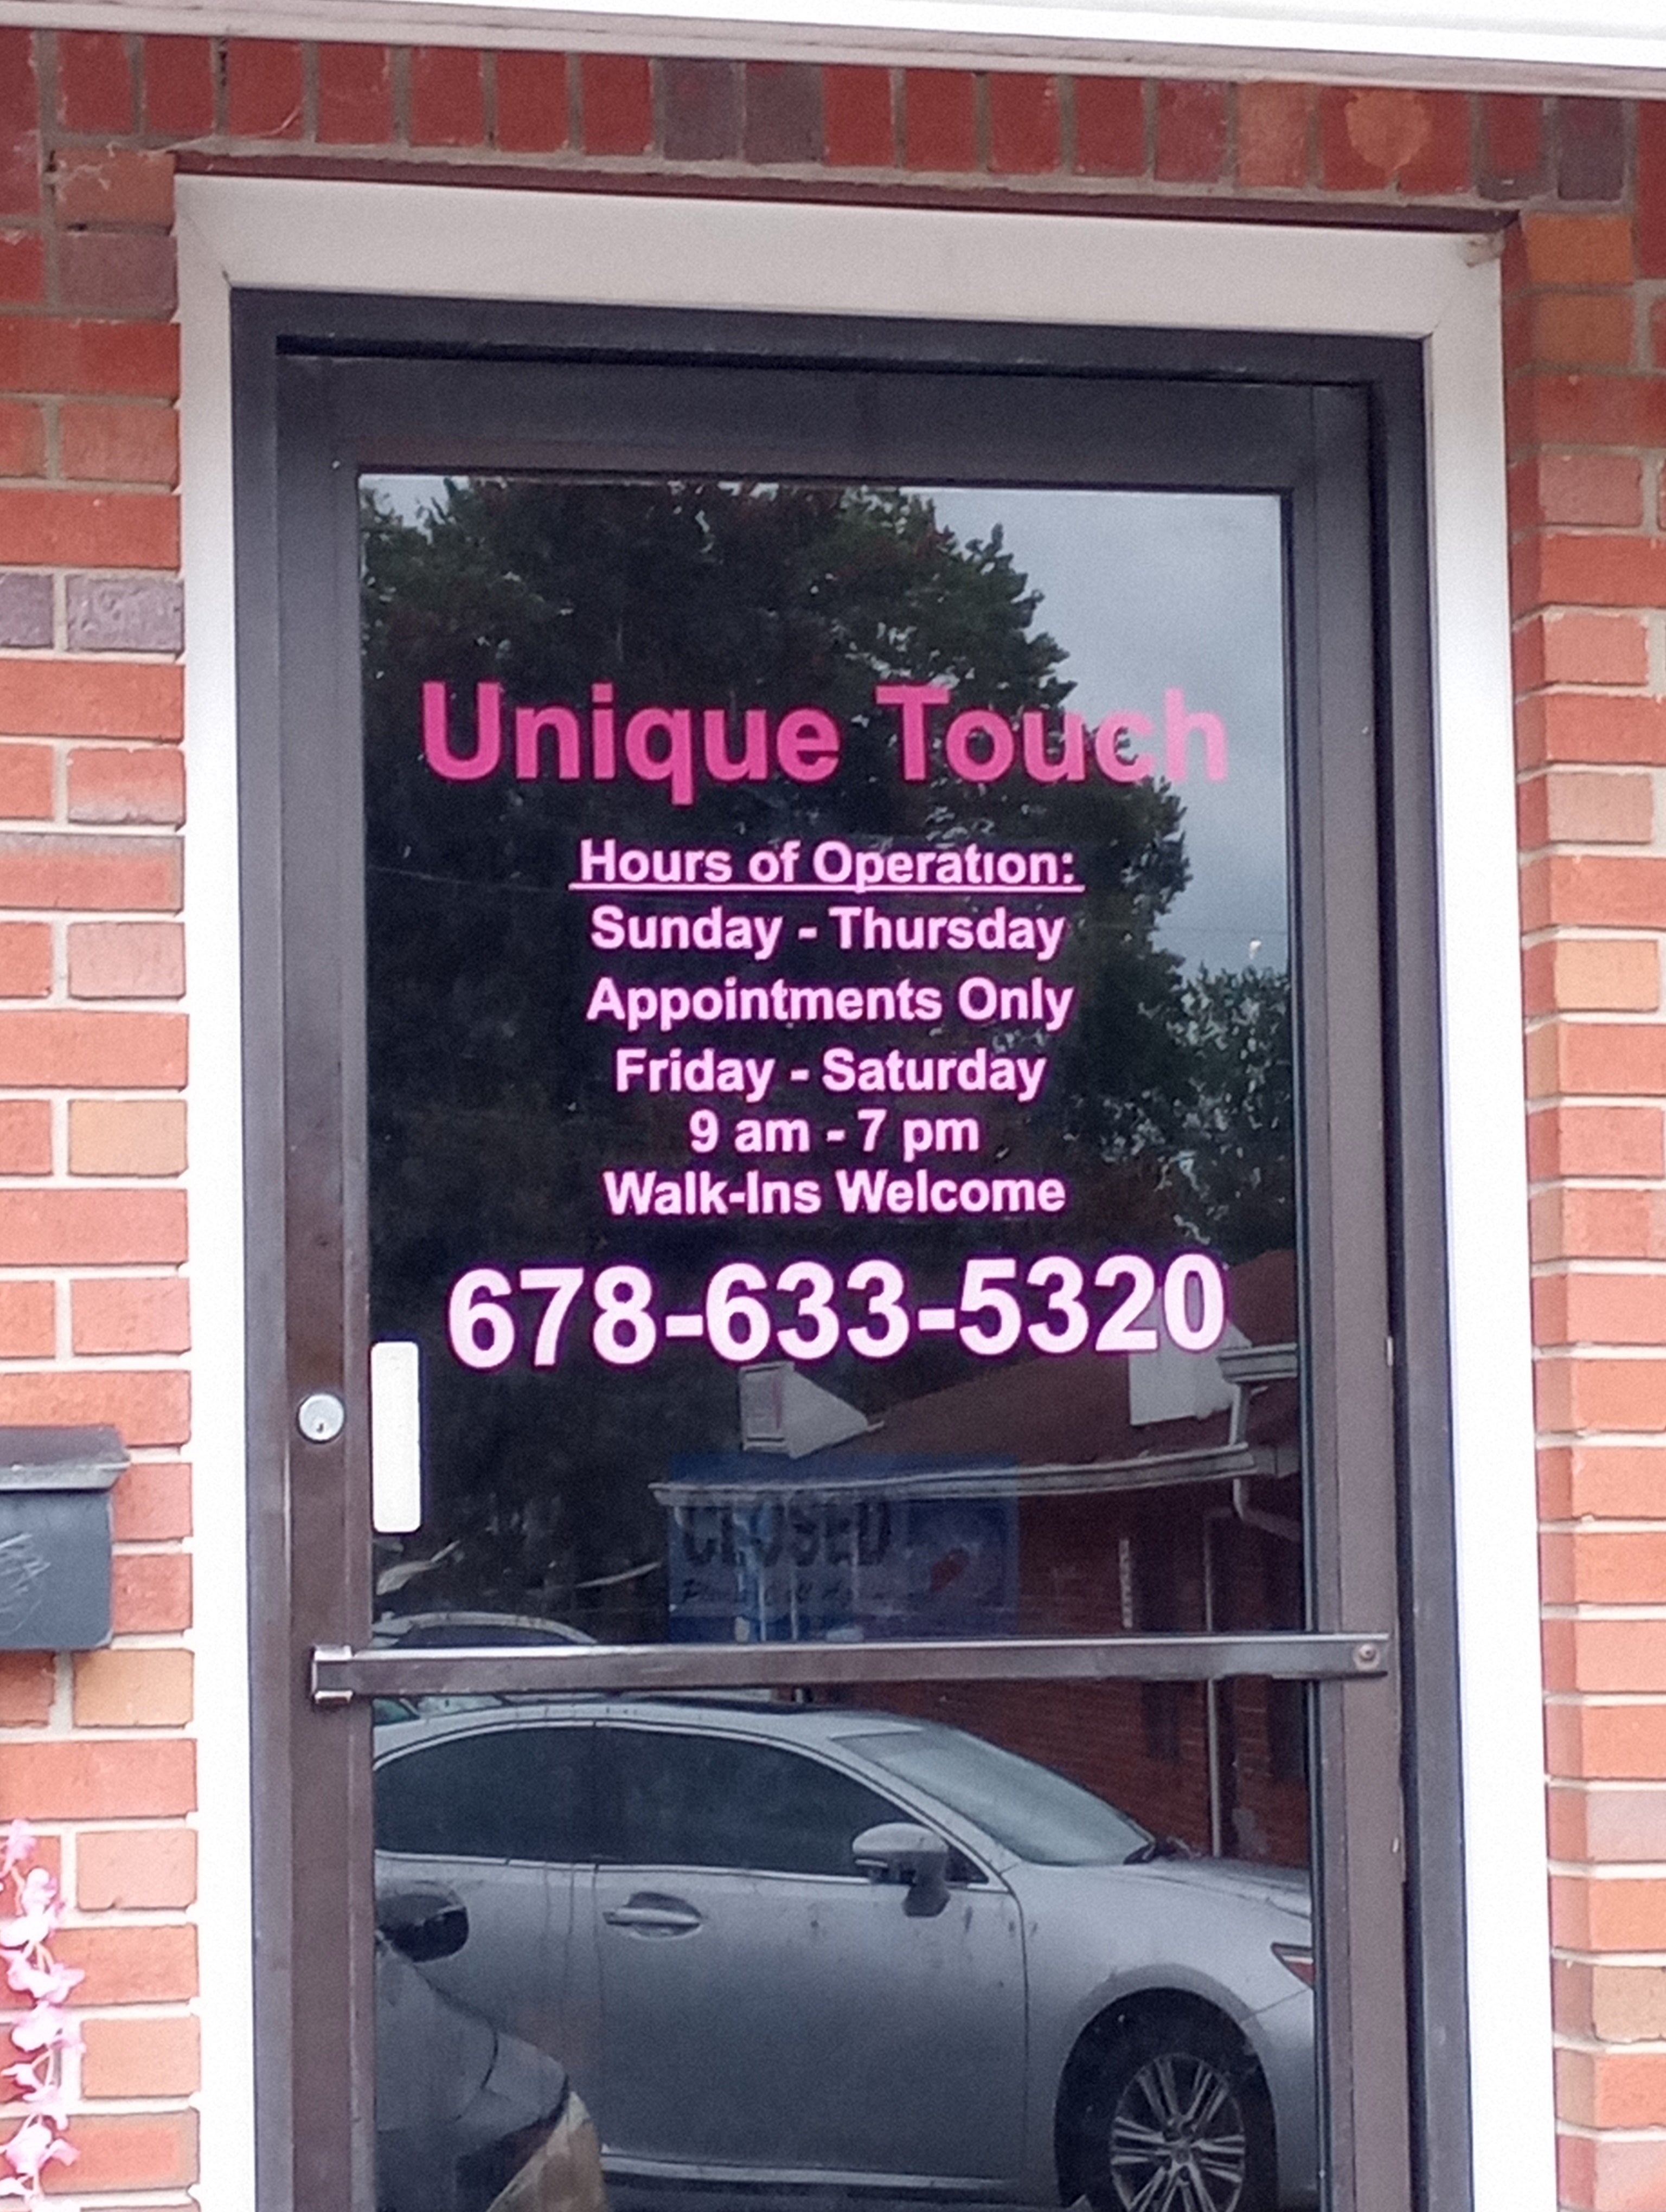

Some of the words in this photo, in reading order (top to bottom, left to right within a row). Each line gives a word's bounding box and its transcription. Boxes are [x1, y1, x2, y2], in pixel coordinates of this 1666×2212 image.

[425, 684, 837, 803] Unique
[878, 682, 1228, 783] Touch
[582, 840, 732, 882] Hours
[749, 841, 800, 882] of
[813, 841, 1078, 893] Operation:
[592, 905, 782, 959] Sunday
[799, 928, 816, 937] -
[829, 907, 1065, 960] Thursday
[587, 977, 941, 1031] Appointments
[959, 978, 1073, 1031] Only
[617, 1049, 774, 1102] Friday
[791, 1070, 808, 1080] -
[823, 1048, 1046, 1101] Saturday
[690, 1110, 718, 1152] 9
[735, 1120, 809, 1152] am
[828, 1130, 844, 1141] -
[858, 1109, 886, 1151] 7
[904, 1119, 978, 1162] pm
[604, 1171, 821, 1214] Walk-Ins
[836, 1169, 1065, 1212] Welcome
[450, 1254, 1224, 1367] 678-633-5320
